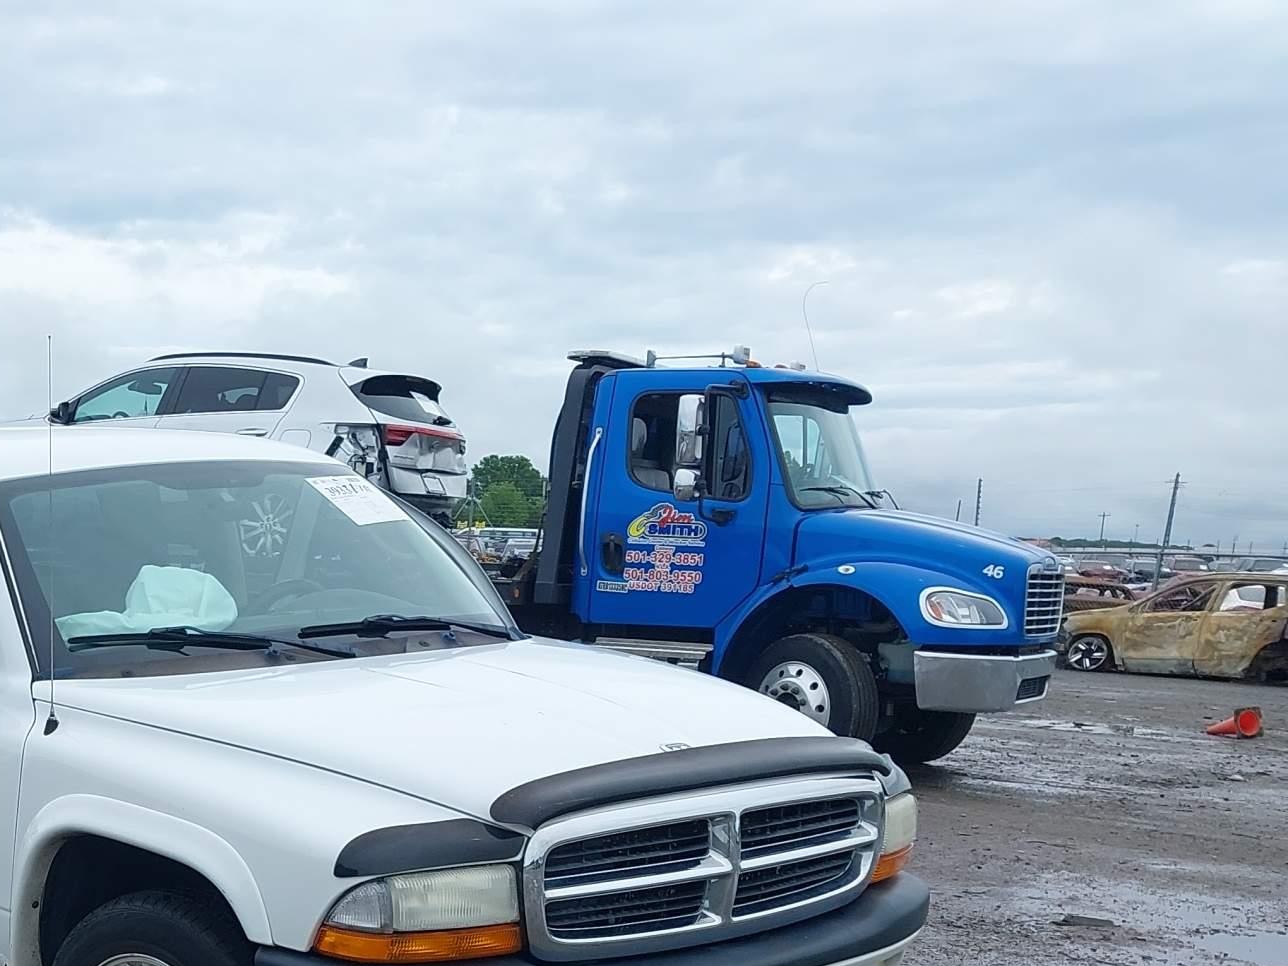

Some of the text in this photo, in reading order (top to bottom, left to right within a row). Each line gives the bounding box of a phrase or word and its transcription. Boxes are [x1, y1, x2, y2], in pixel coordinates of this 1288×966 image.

[659, 506, 693, 527] Jim
[648, 523, 700, 537] SMITH
[626, 551, 703, 565] 501-329-3851
[624, 569, 701, 583] 501-803-9550
[982, 564, 1005, 579] 46
[629, 582, 659, 591] USDOT
